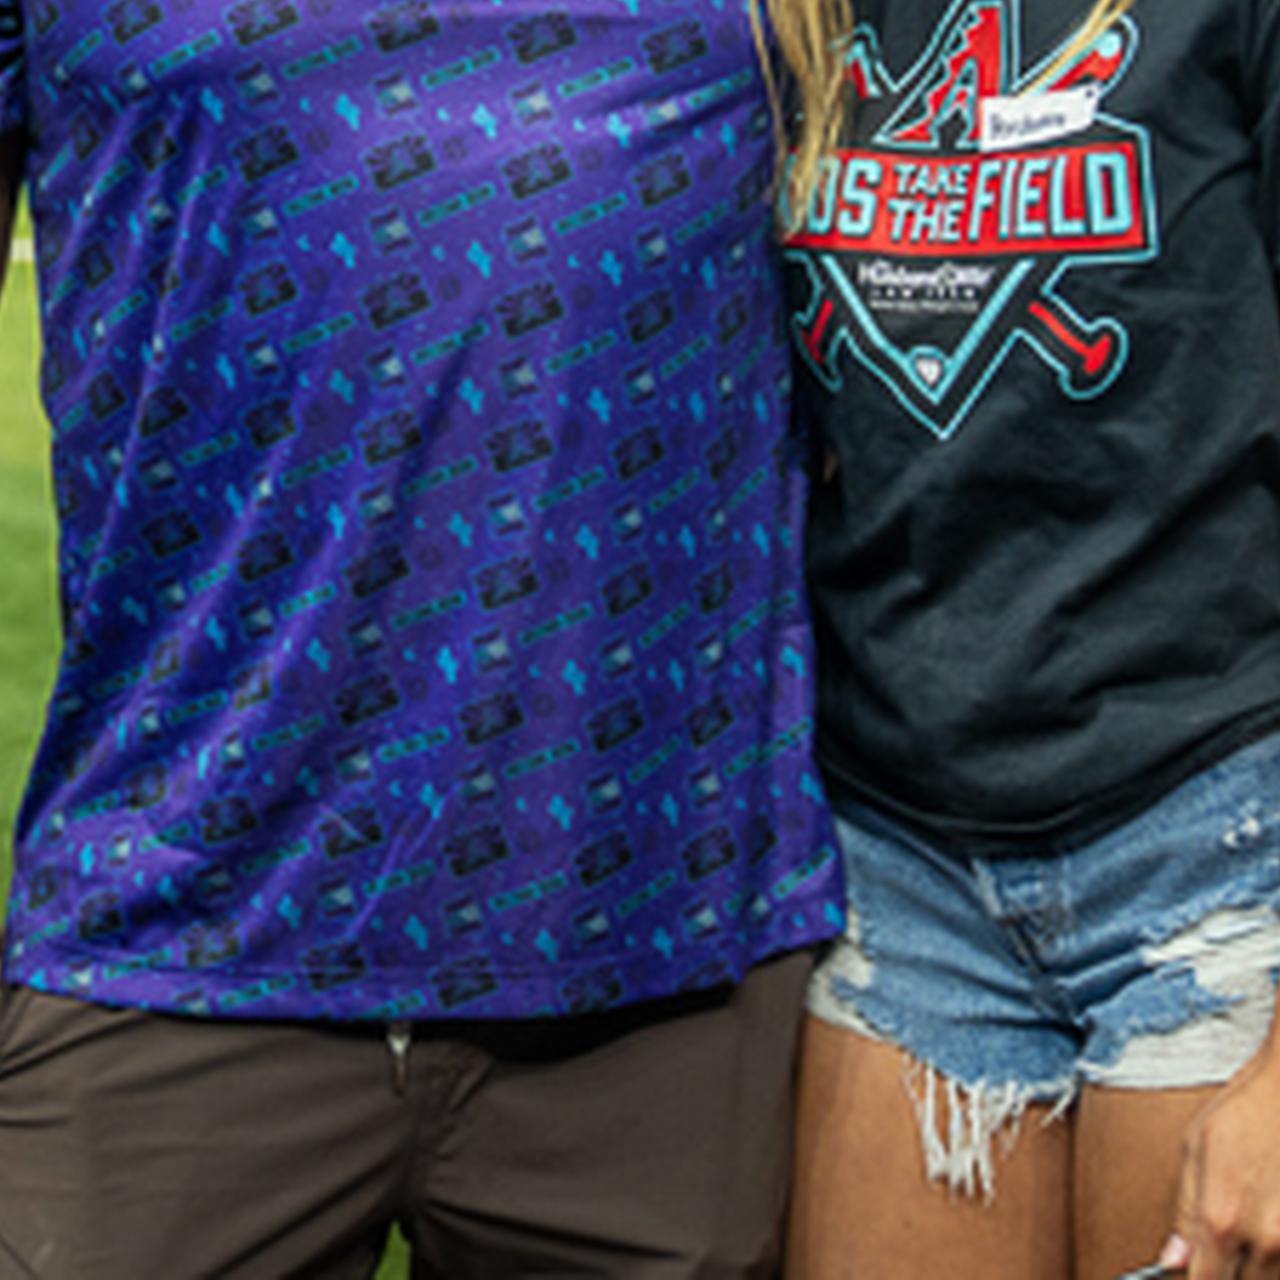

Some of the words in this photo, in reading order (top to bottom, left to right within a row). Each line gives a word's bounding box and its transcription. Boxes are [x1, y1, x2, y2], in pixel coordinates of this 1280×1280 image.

[892, 164, 971, 195] TAKE
[966, 152, 1134, 242] FIELD
[887, 199, 966, 242] THE
